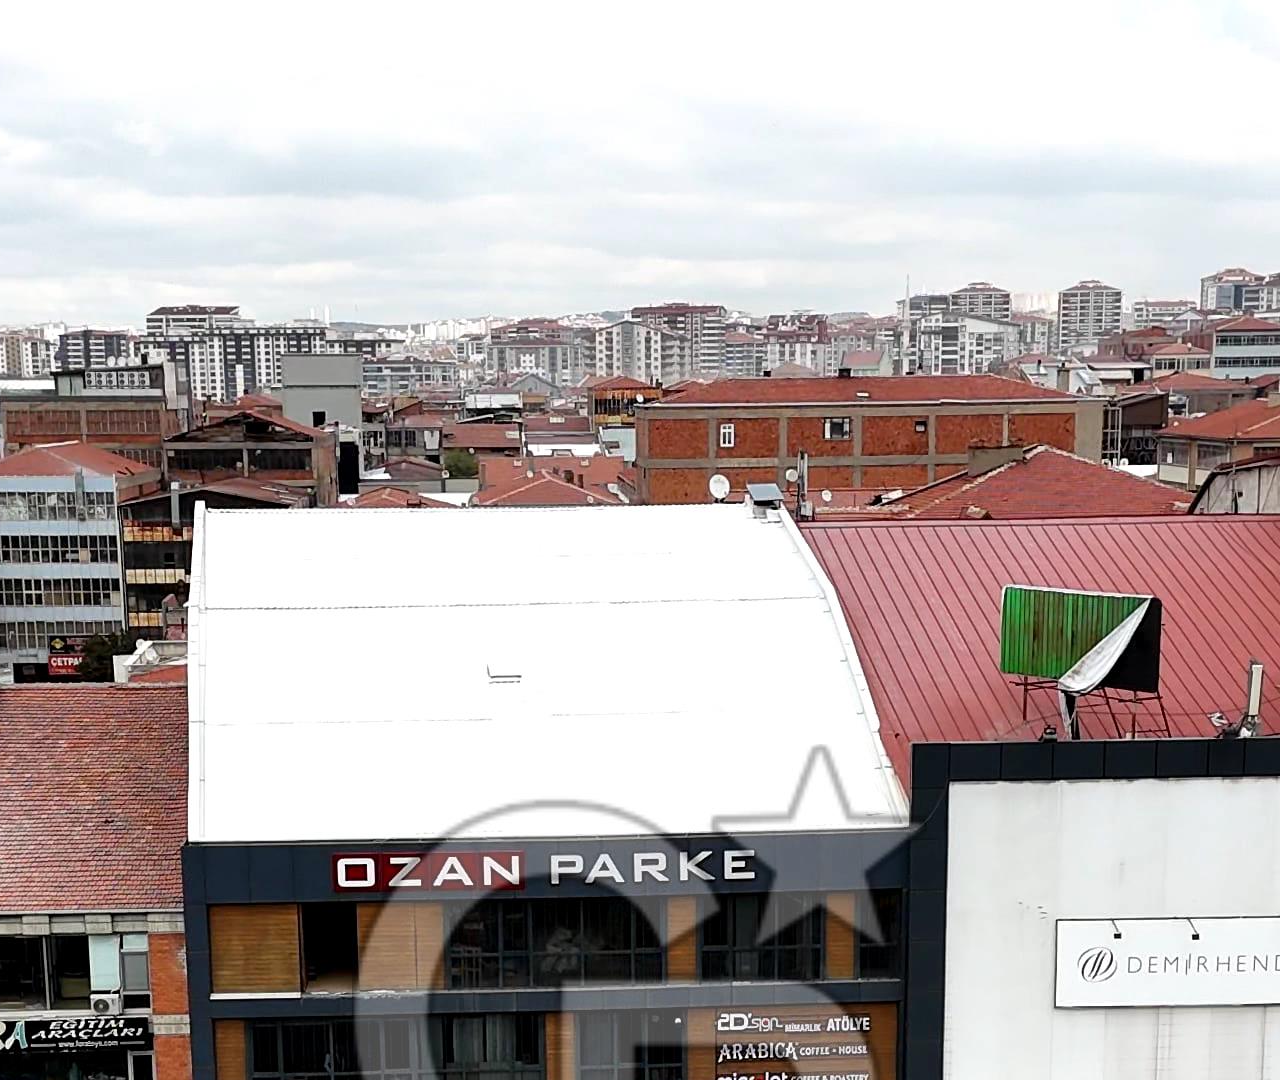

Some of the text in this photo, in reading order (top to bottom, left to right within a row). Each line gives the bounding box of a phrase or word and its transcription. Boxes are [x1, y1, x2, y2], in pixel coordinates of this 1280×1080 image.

[337, 850, 756, 888] OZAN PARKE
[827, 1016, 870, 1031] ATÖLYE
[32, 1027, 144, 1040] ARAÇLARI
[718, 1042, 799, 1063] ARABICA
